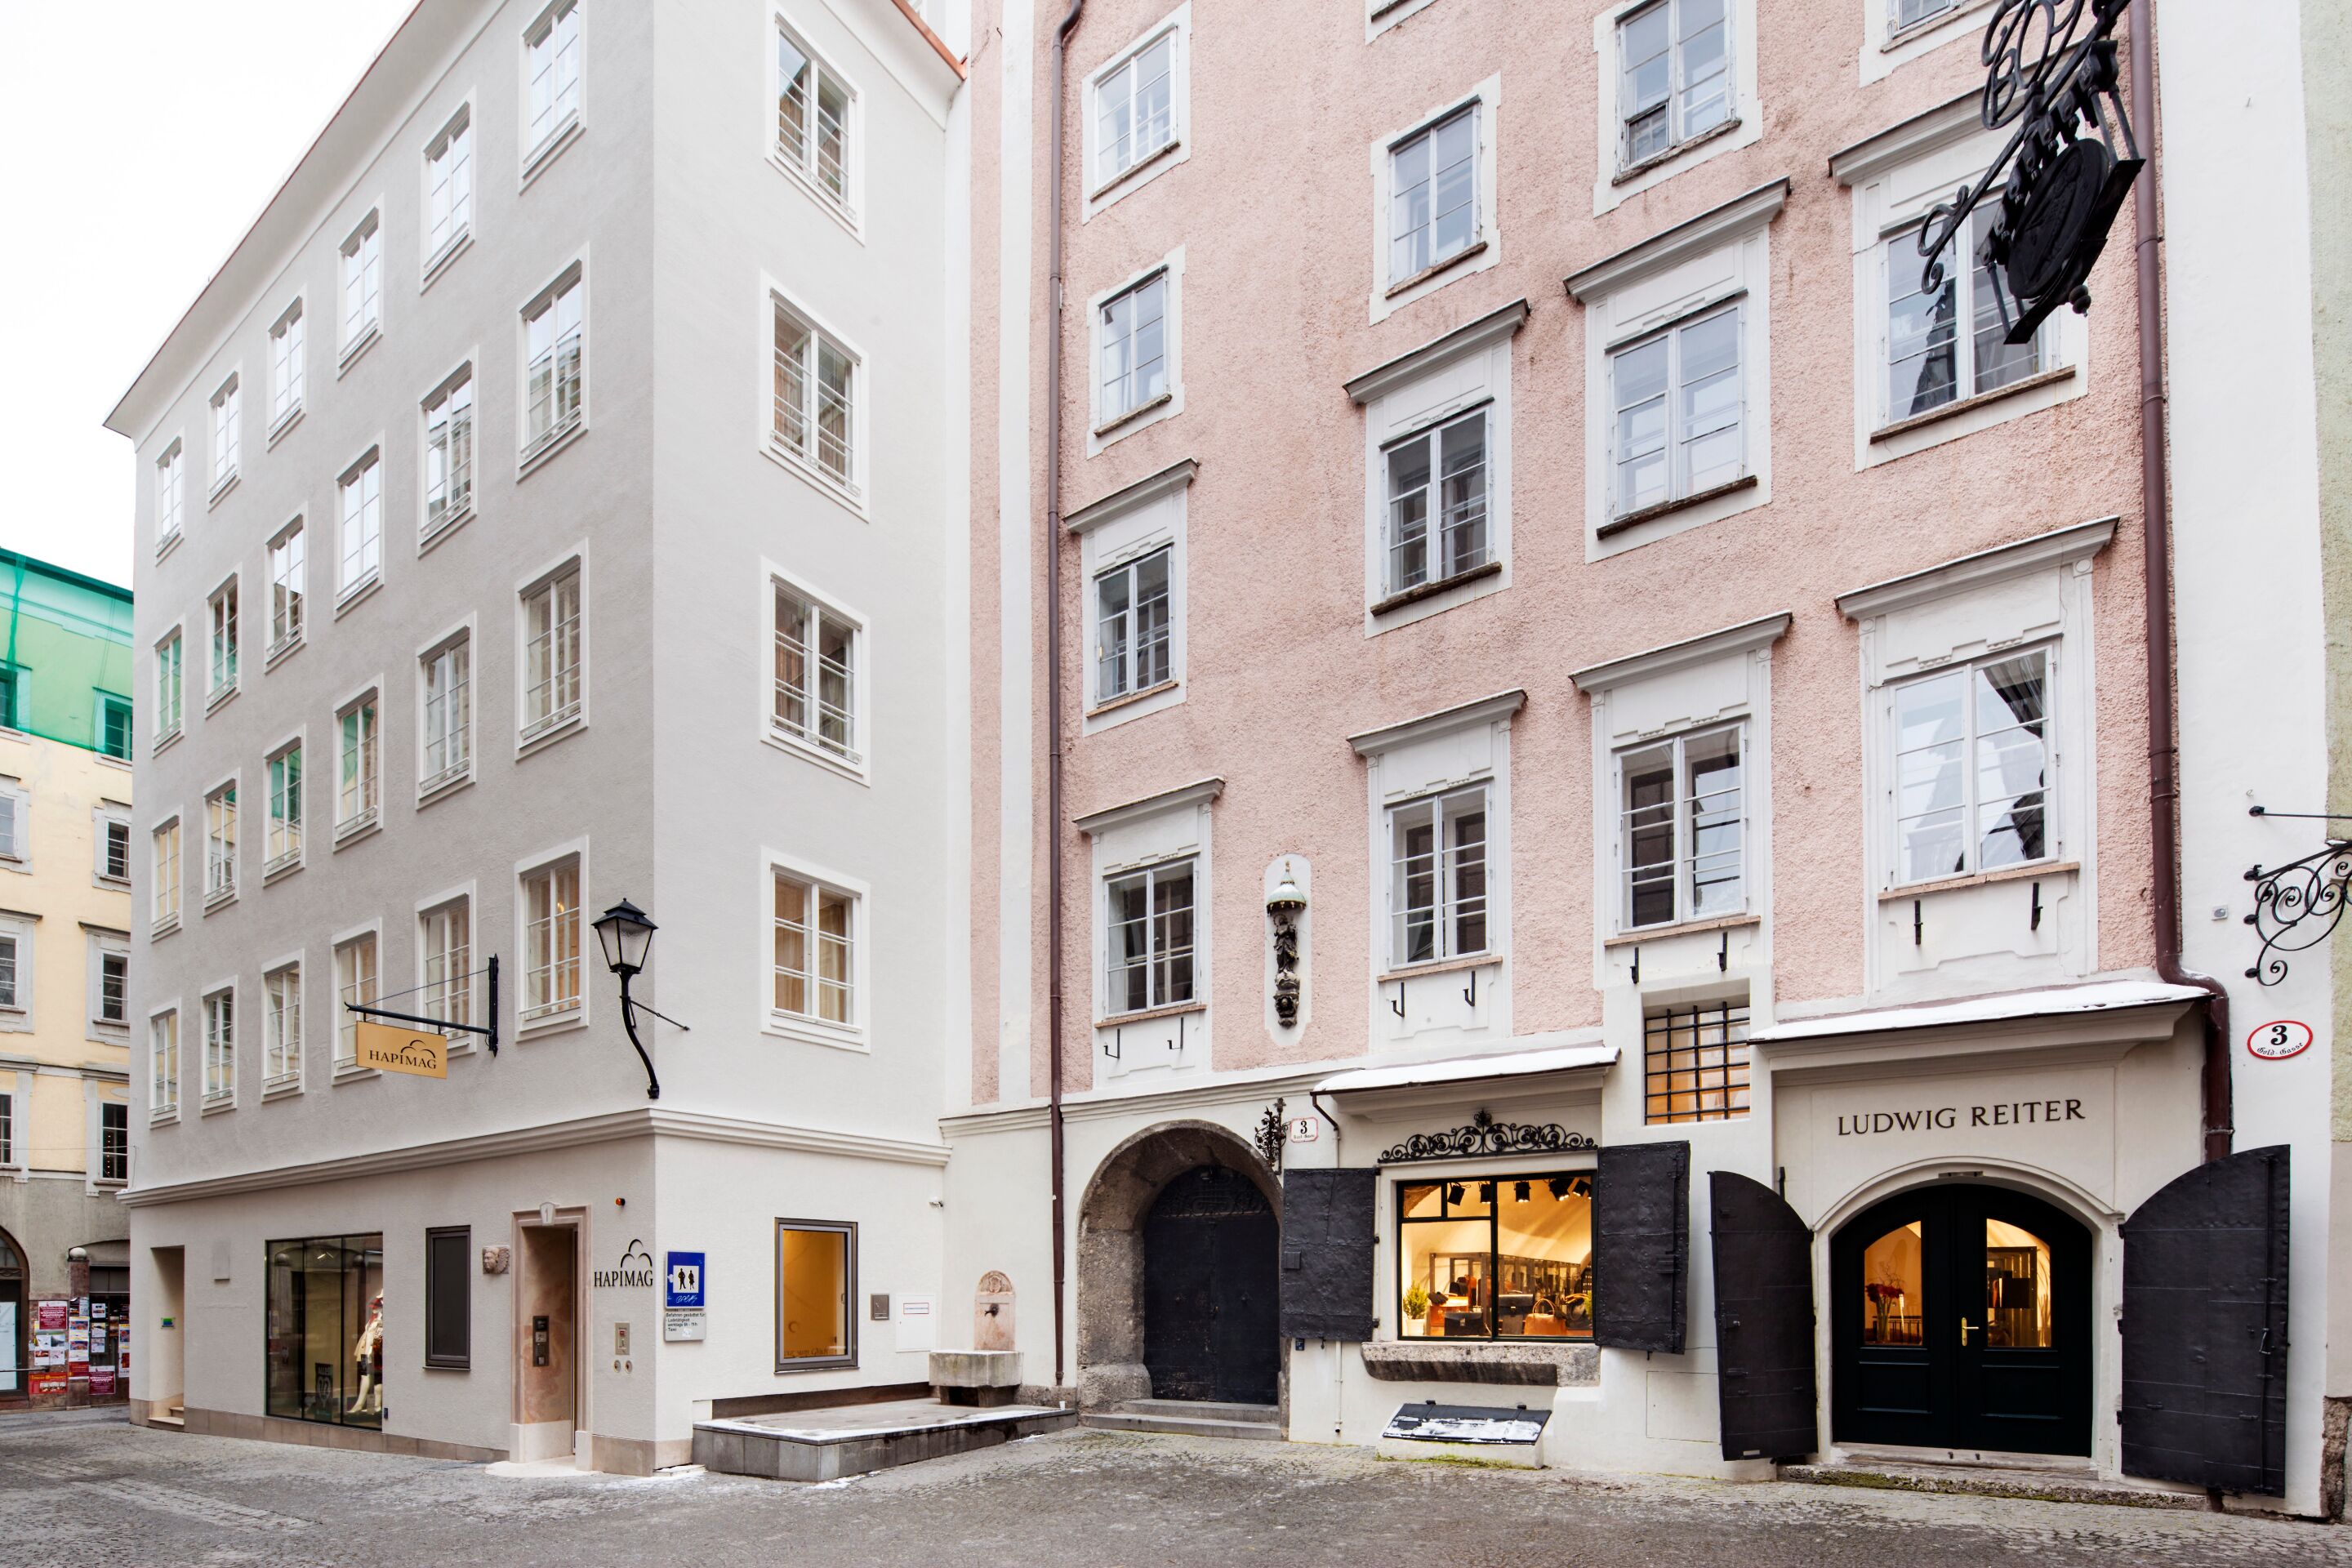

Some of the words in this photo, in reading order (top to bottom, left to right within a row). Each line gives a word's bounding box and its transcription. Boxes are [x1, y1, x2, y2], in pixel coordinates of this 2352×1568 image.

[2270, 1025, 2287, 1046] 3
[369, 1050, 437, 1069] HAPIMAG
[1838, 1107, 1957, 1136] LUDWIG
[1971, 1098, 2087, 1127] REITER
[1300, 1120, 1307, 1134] 3
[594, 1269, 653, 1288] HAPIMAG
